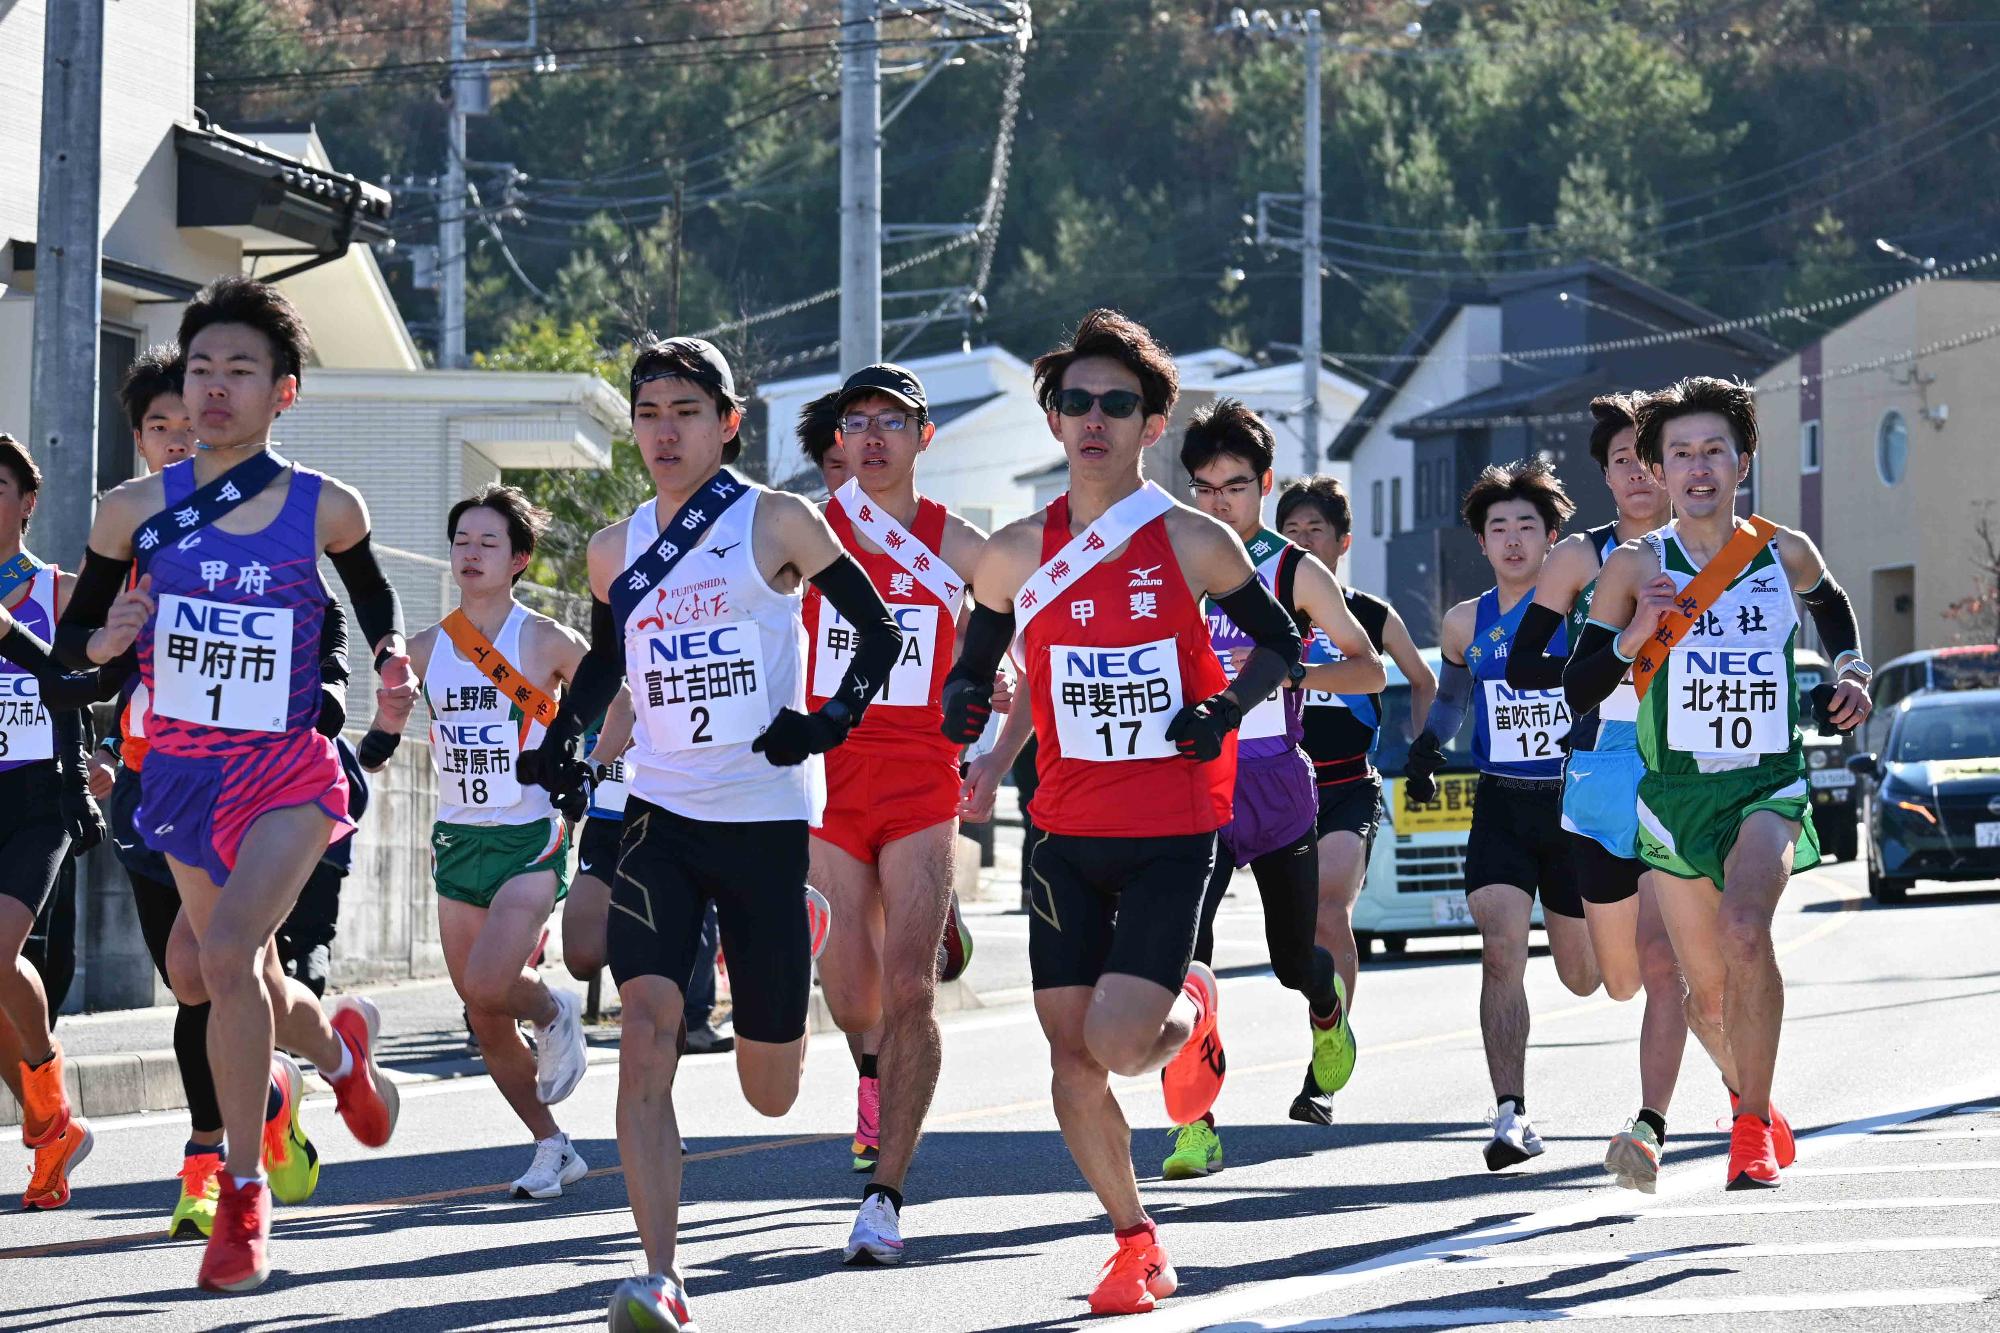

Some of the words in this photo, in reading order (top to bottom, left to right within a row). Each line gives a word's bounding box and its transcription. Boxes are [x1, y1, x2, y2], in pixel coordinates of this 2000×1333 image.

[138, 480, 242, 550] 甲府市
[858, 504, 960, 600] 甲斐市A
[199, 560, 272, 596] 甲府
[1019, 531, 1105, 609] 甲斐市
[671, 577, 727, 599] FUJIYOSHIDA
[174, 601, 276, 641] NEC
[1640, 596, 1699, 674] 北杜市
[1692, 605, 1768, 637] 北杜
[167, 633, 277, 684] 甲府市
[648, 627, 741, 665] NEC
[1066, 646, 1161, 678] NEC
[1686, 651, 1774, 675] NEC
[0, 676, 38, 697] EC
[441, 685, 499, 712] 上野原
[473, 646, 551, 717] 上野原市
[644, 658, 757, 708] 富士吉田市
[1062, 677, 1172, 718] 甲斐市B
[1682, 679, 1778, 713] 北杜市
[206, 684, 223, 721] 1
[1494, 701, 1571, 731] 笛吹市A
[439, 724, 504, 745] NEC
[690, 706, 713, 744] 2
[1096, 721, 1142, 756] 17
[1708, 716, 1753, 748] 10
[442, 746, 511, 776] 上野原市
[1516, 731, 1552, 758] 12
[457, 777, 489, 805] 18
